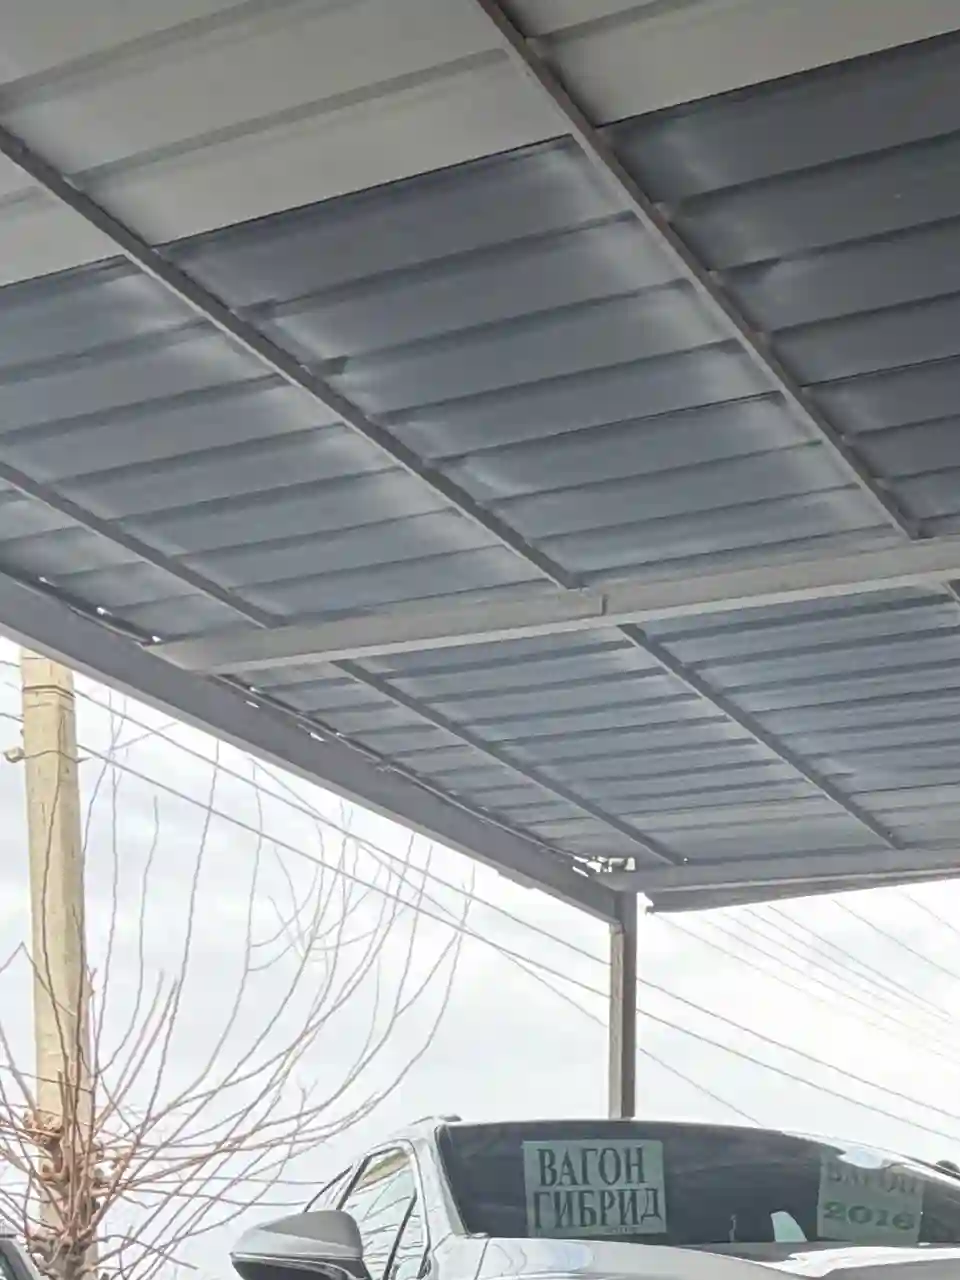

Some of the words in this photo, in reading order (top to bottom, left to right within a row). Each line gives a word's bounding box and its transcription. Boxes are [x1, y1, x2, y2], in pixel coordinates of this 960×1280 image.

[536, 1146, 649, 1186] ВАГОН
[533, 1187, 662, 1230] ГИБРИД
[823, 1201, 915, 1231] 2016
